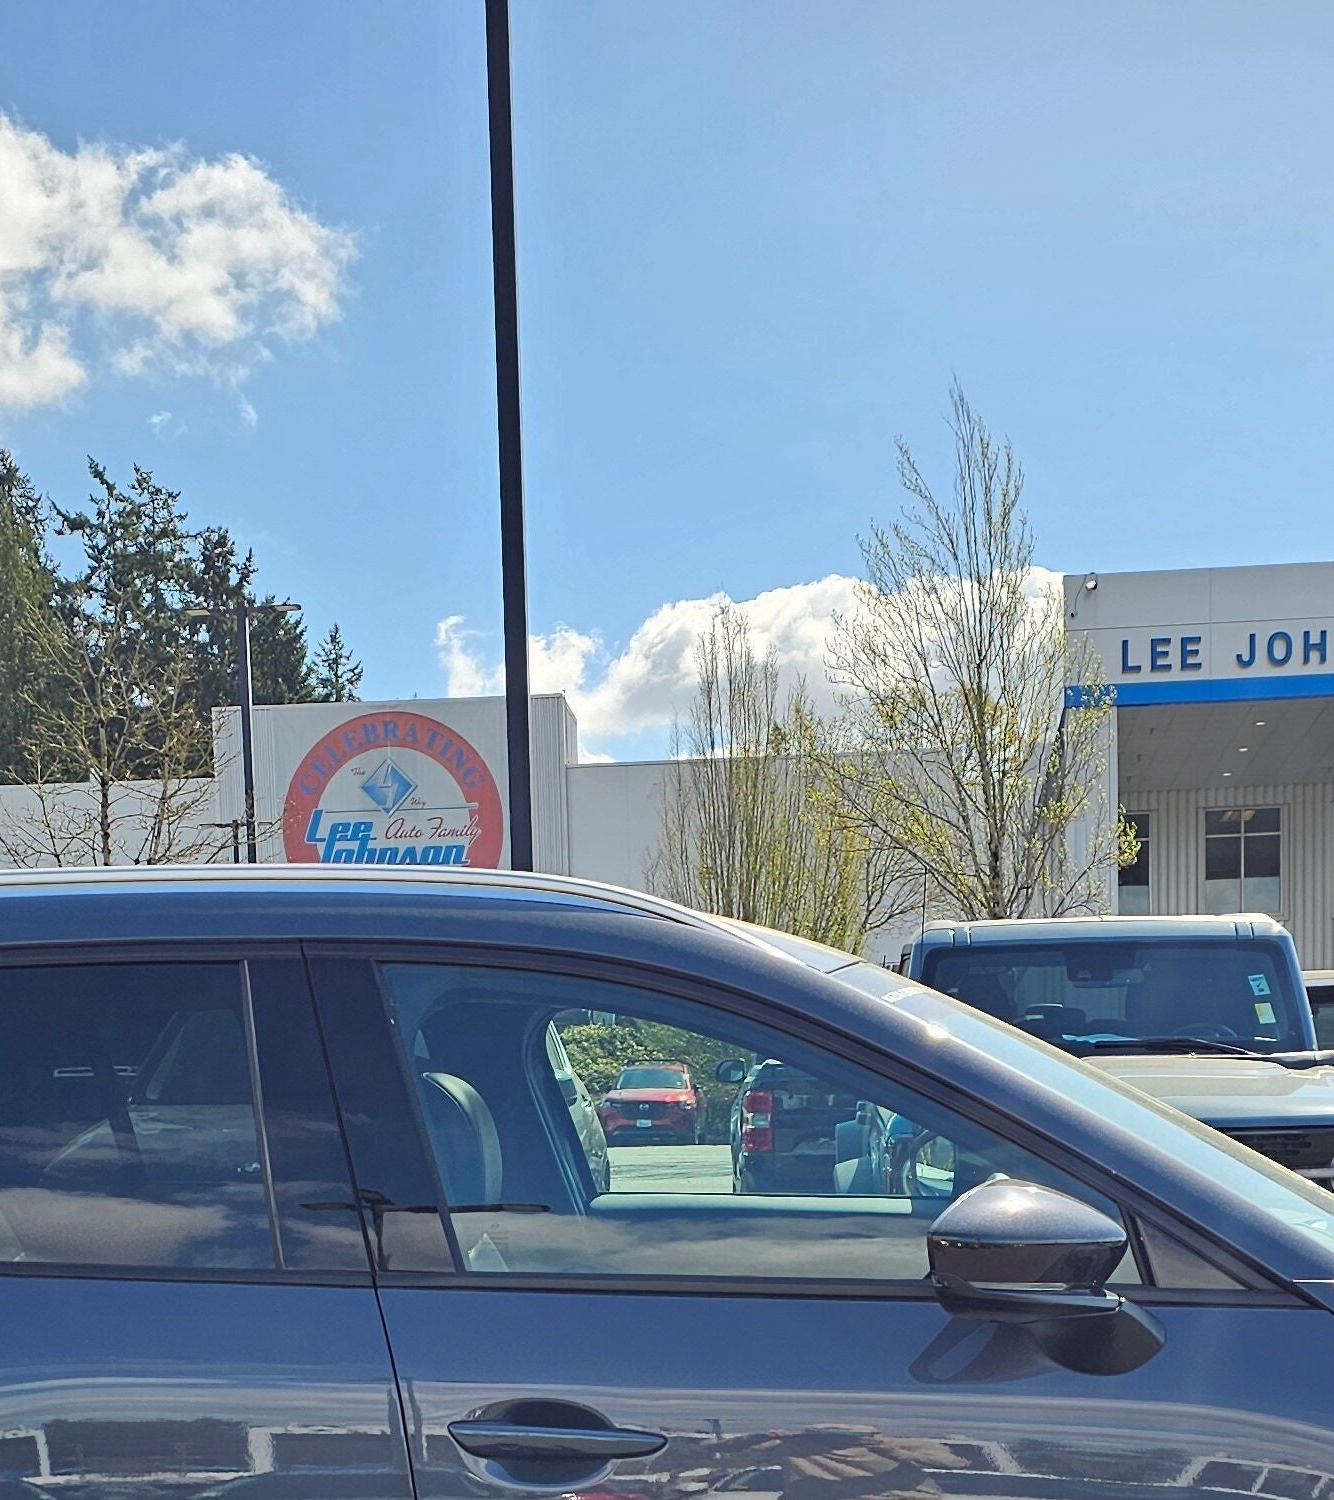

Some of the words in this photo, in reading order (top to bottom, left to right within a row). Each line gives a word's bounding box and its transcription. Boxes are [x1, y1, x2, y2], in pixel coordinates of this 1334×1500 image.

[1120, 636, 1202, 673] LEE
[299, 720, 485, 795] CELEBRATING
[306, 809, 377, 843] Lee
[385, 817, 424, 840] Auto
[427, 815, 481, 845] Family
